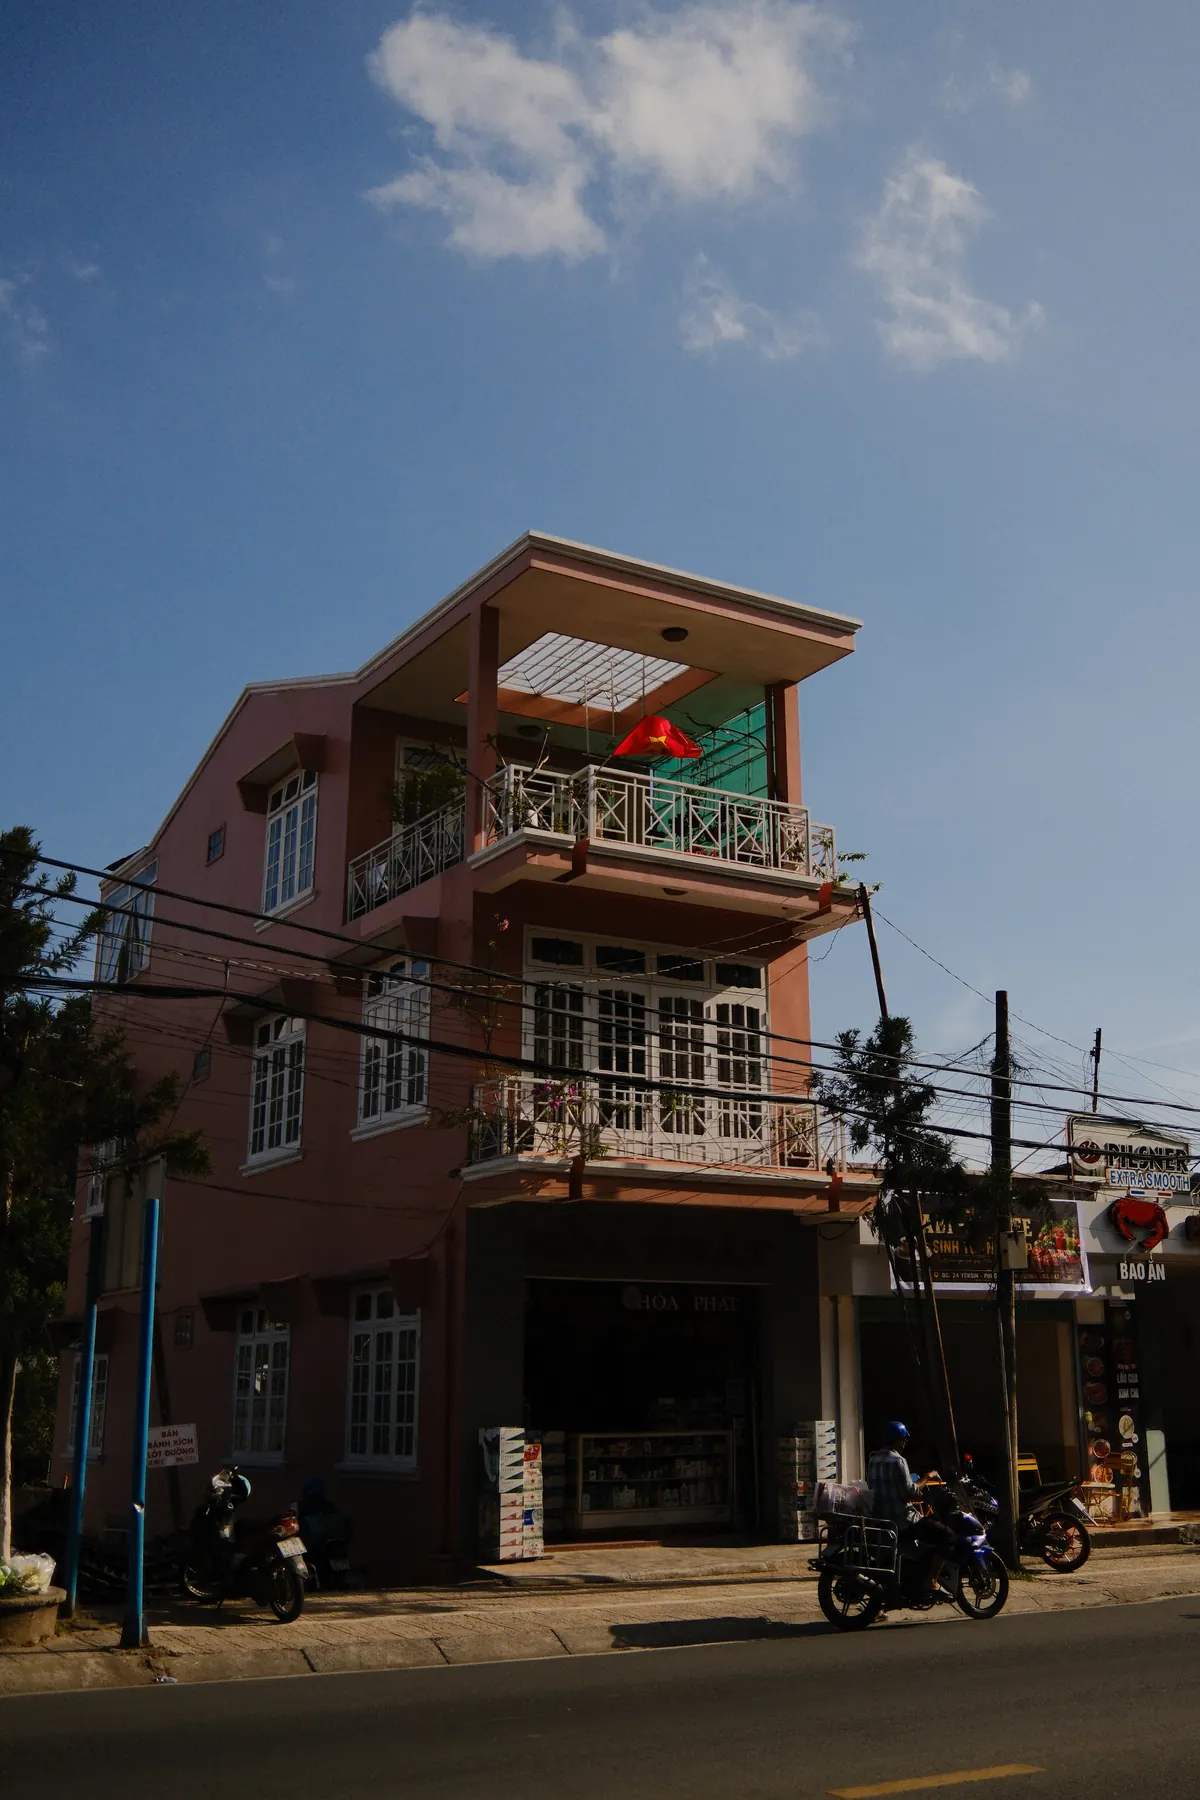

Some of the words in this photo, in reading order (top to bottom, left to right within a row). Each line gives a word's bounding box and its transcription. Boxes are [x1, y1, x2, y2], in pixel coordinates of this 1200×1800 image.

[1110, 1170, 1146, 1185] EXTRA
[1146, 1172, 1189, 1189] SMOOTH
[932, 1240, 960, 1254] SINH
[1119, 1262, 1146, 1280] BAO
